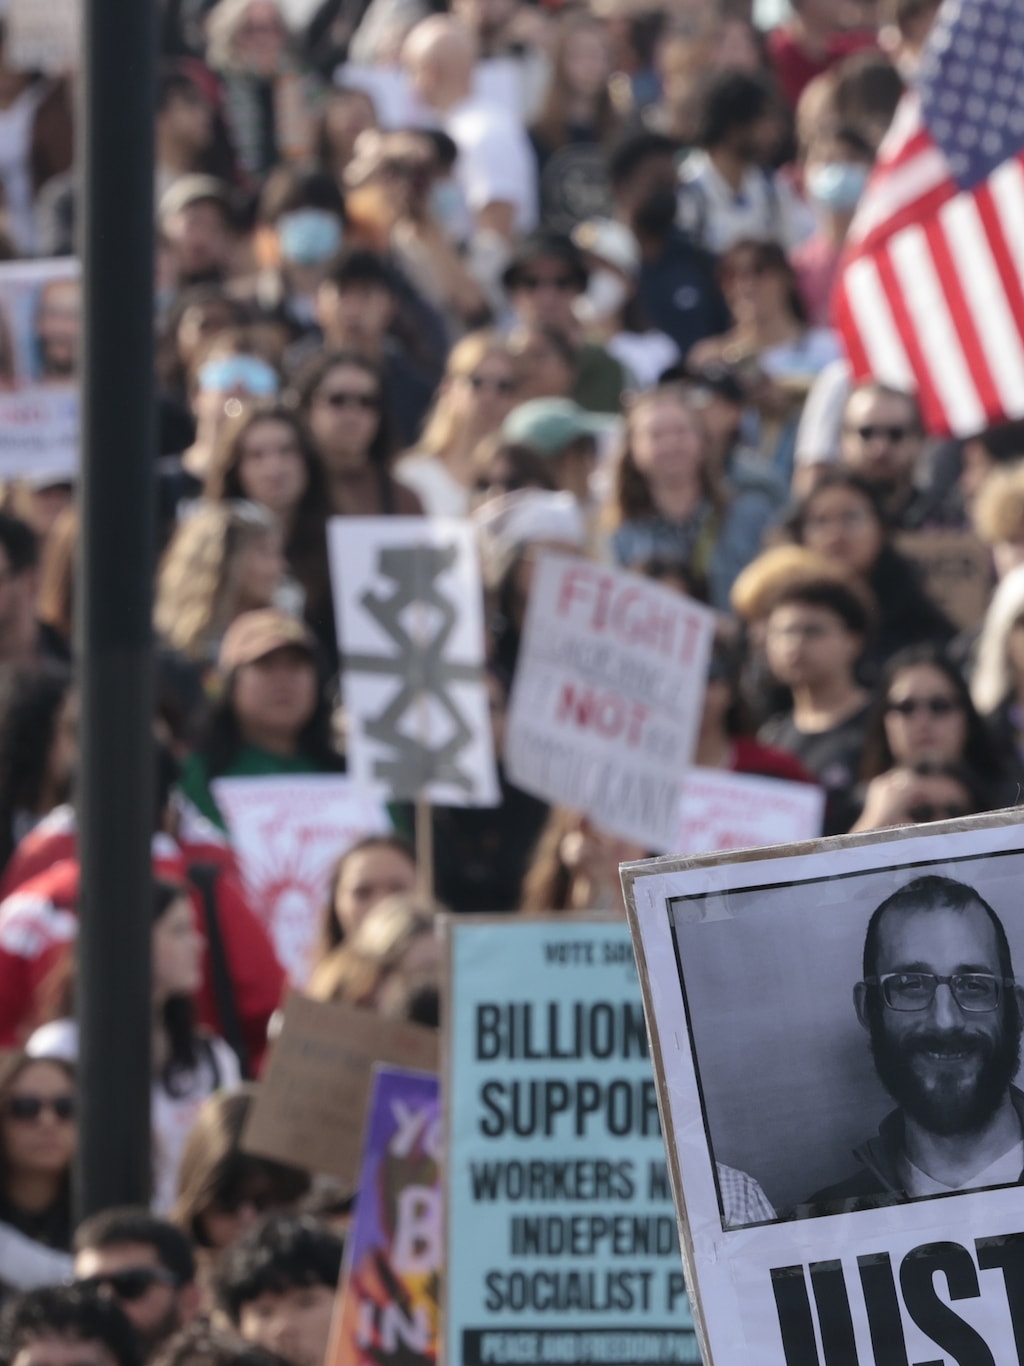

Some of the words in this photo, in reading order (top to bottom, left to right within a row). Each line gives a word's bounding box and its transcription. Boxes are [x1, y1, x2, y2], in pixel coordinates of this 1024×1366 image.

[556, 563, 702, 666] FIGHT
[555, 682, 652, 748] NOT
[544, 940, 595, 965] VOTE
[471, 1160, 635, 1203] WORKERS
[485, 1270, 654, 1314] SOCIALIST
